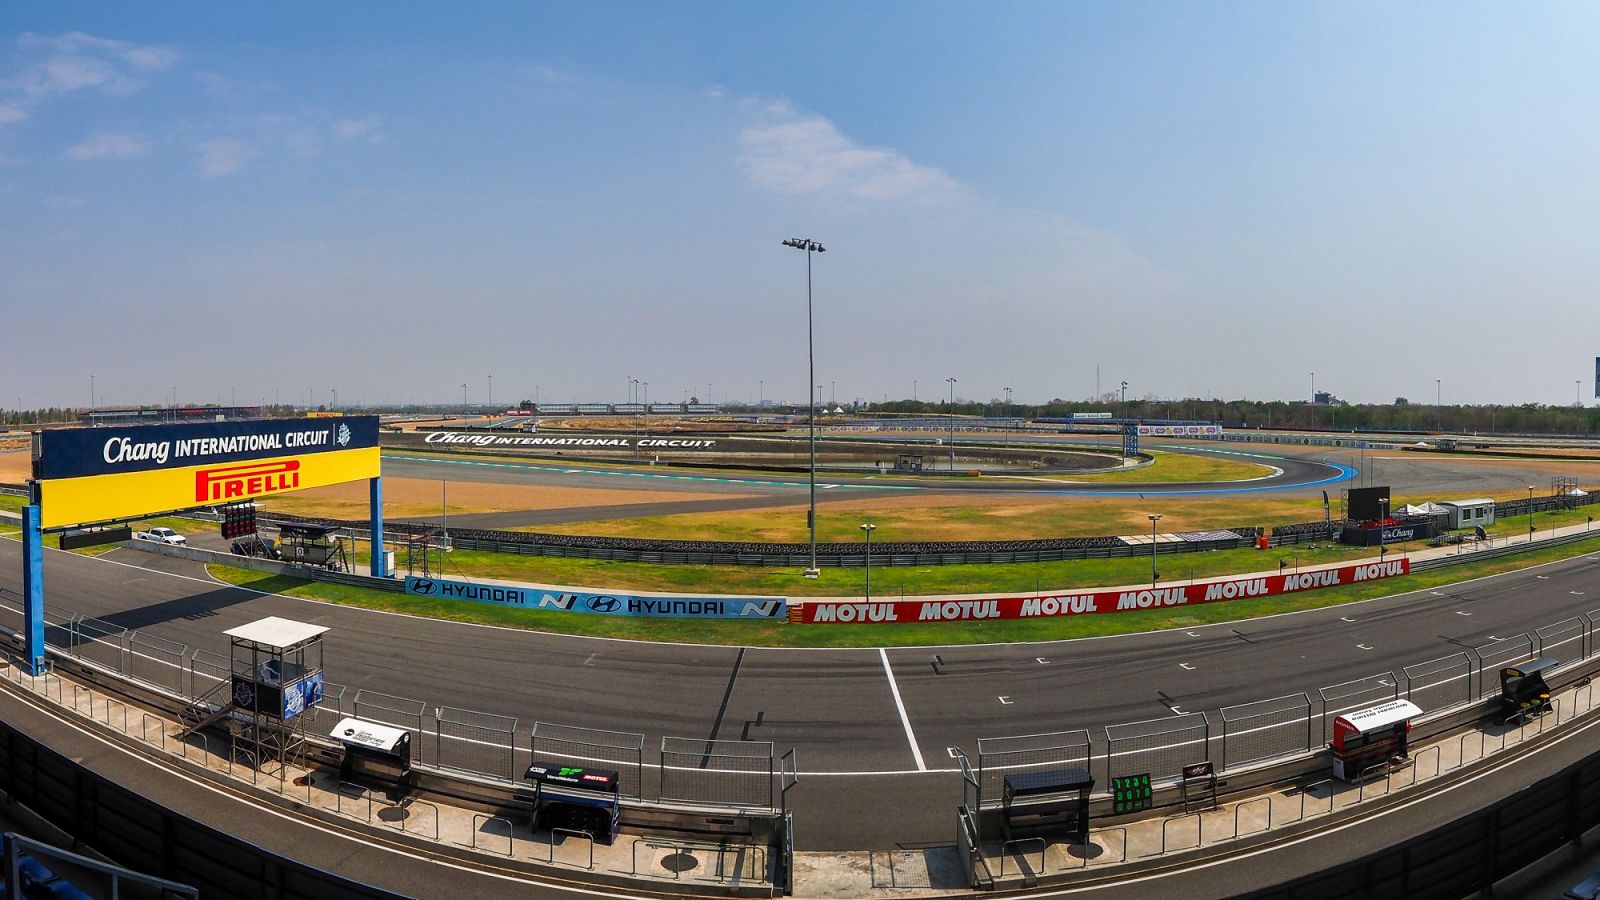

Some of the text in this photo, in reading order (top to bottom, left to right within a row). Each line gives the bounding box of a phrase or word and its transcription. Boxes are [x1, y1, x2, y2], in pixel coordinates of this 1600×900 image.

[103, 430, 329, 464] Chang INTERNATIONAL CIRCUIT
[424, 431, 497, 446] Chang
[495, 437, 630, 447] INTERNATIONAL
[195, 460, 300, 502] PIRELLI
[1283, 570, 1340, 591] MOTUL
[1354, 561, 1404, 582] MOTUL
[442, 583, 525, 604] HYUNDAI
[1117, 588, 1188, 610] MOTUL
[1205, 579, 1268, 600] MOTUL
[628, 600, 724, 615] HYUNDAI
[813, 604, 897, 622] MOTUL
[919, 601, 1000, 620] MOTUL
[1020, 595, 1097, 617] MOTUL
